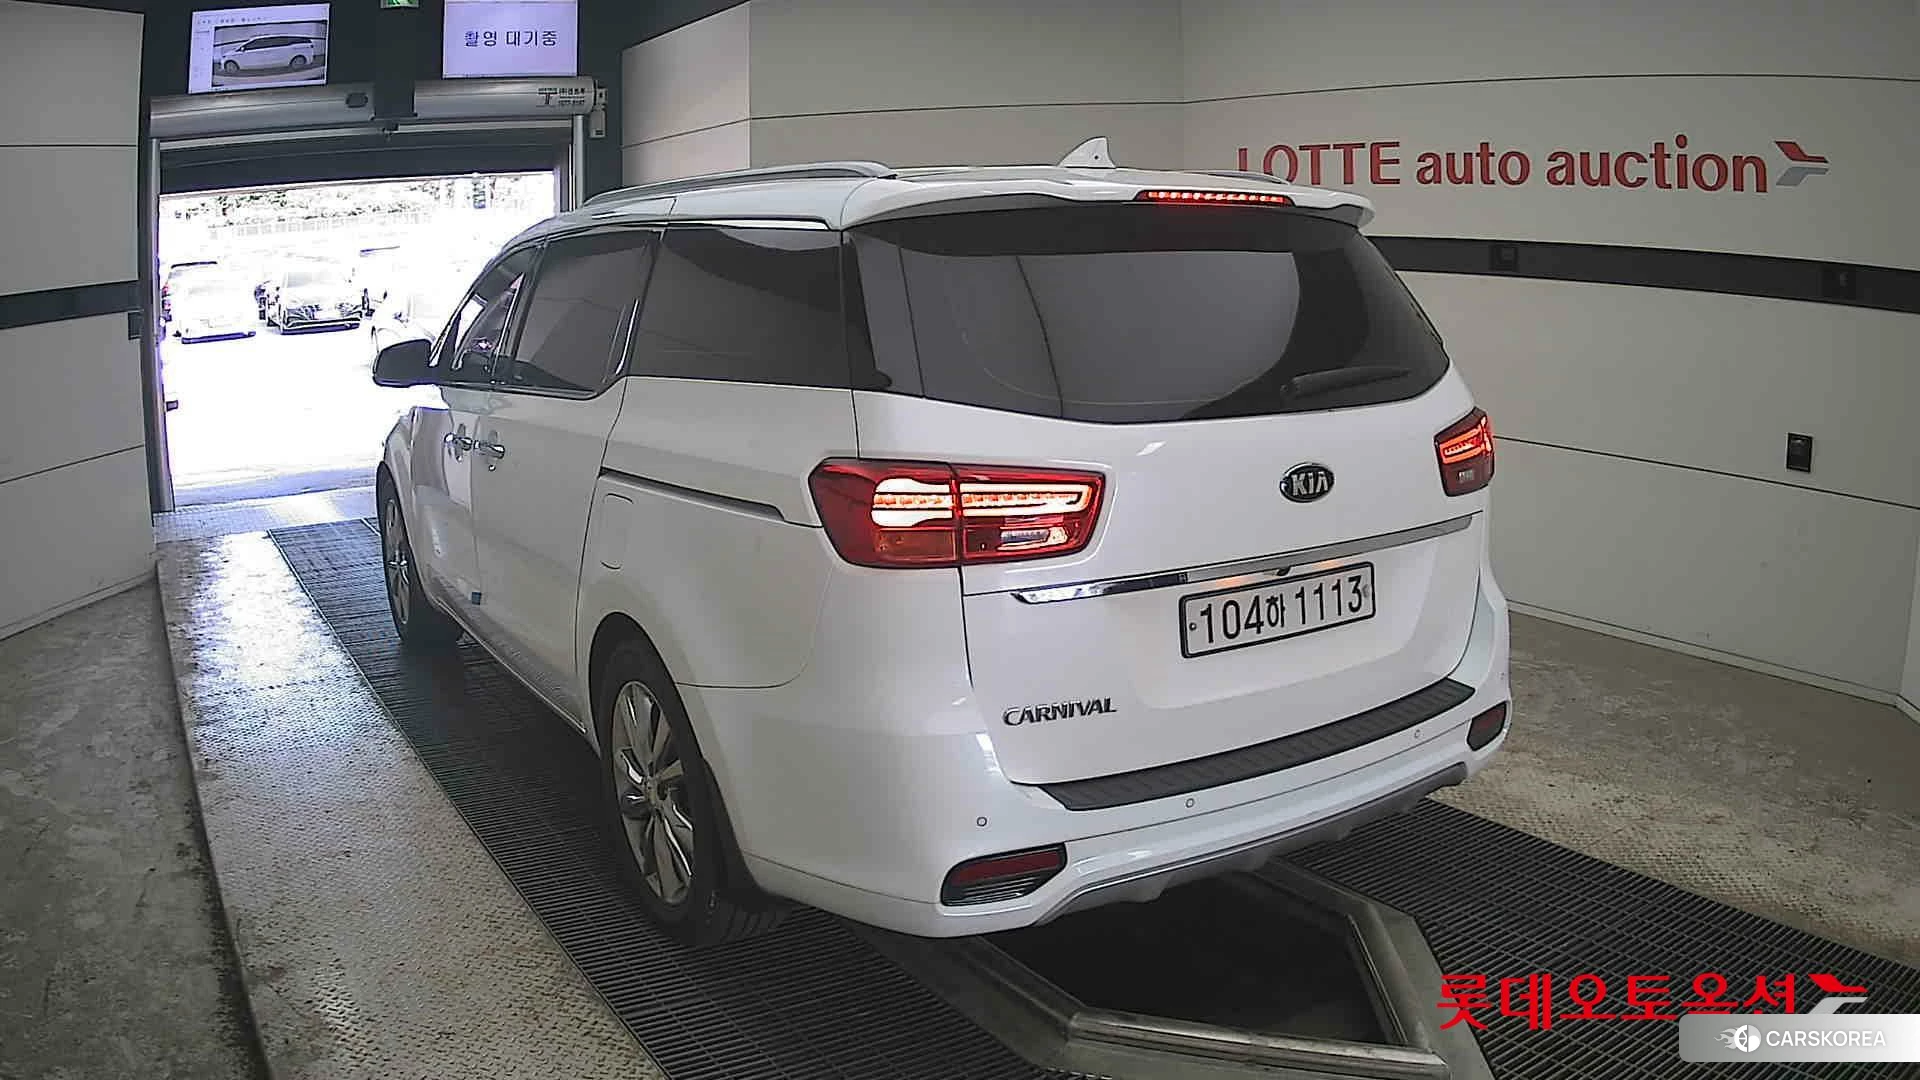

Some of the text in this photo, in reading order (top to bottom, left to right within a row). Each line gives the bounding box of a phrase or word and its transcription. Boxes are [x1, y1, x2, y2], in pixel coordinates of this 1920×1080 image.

[464, 30, 558, 48] 촬영 대기중
[1416, 141, 1530, 187] auto
[1546, 134, 1768, 194] auction
[1290, 471, 1329, 496] KIA
[1200, 574, 1363, 643] 104하 1113
[1002, 697, 1117, 727] CARNIVAL
